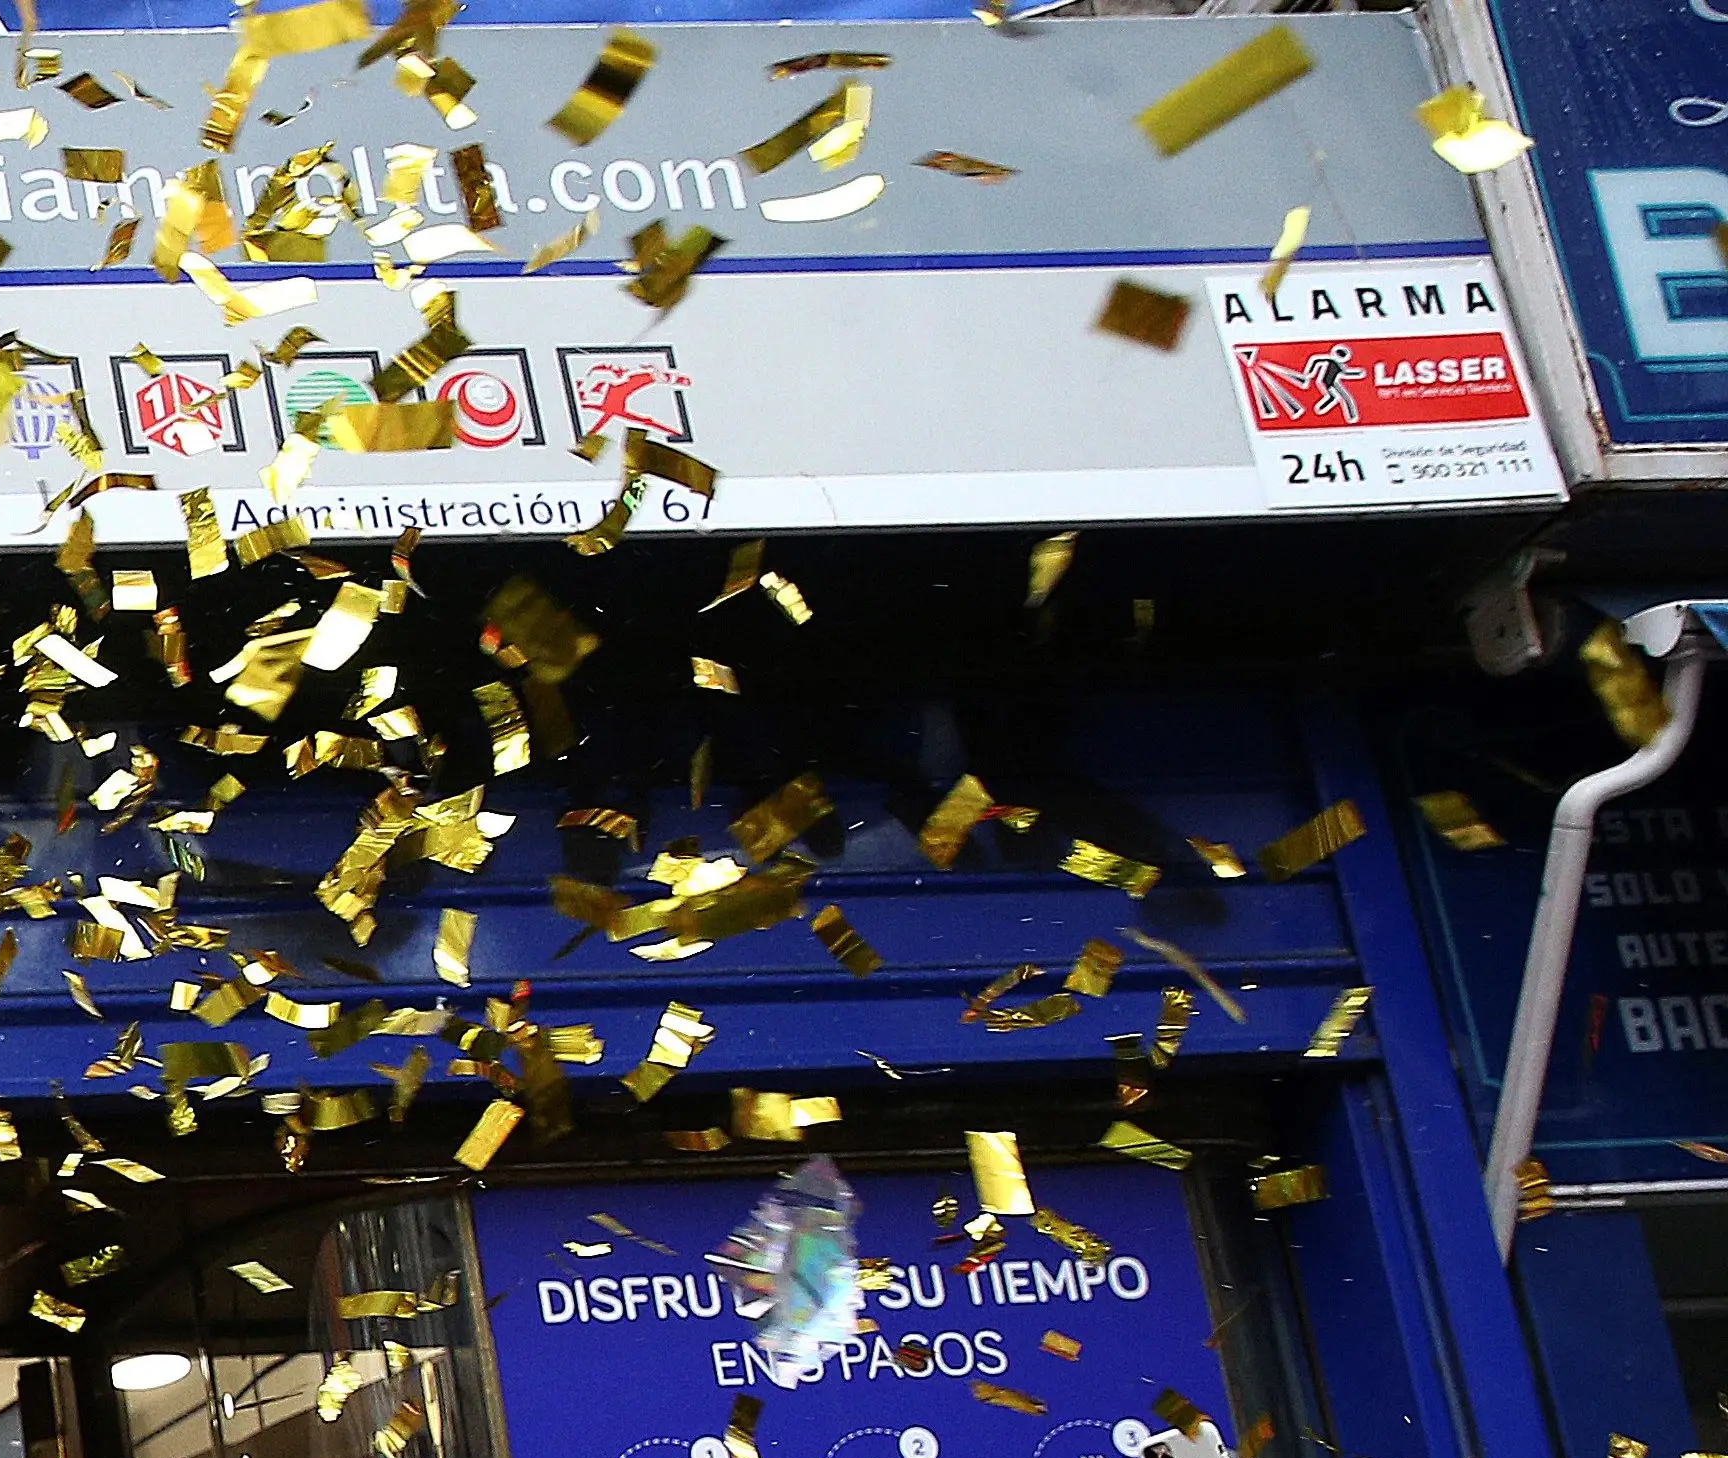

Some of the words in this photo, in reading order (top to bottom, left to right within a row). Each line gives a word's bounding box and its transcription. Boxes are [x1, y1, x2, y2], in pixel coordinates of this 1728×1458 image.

[1224, 282, 1497, 324] ALARMA
[1374, 356, 1507, 387] LASSER
[1281, 450, 1367, 485] 24h
[230, 487, 580, 532] Administración
[1590, 806, 1694, 845] STA
[538, 1272, 734, 1325] DISFRU
[878, 1263, 946, 1311] SU
[965, 1254, 1151, 1307] TIEMPO
